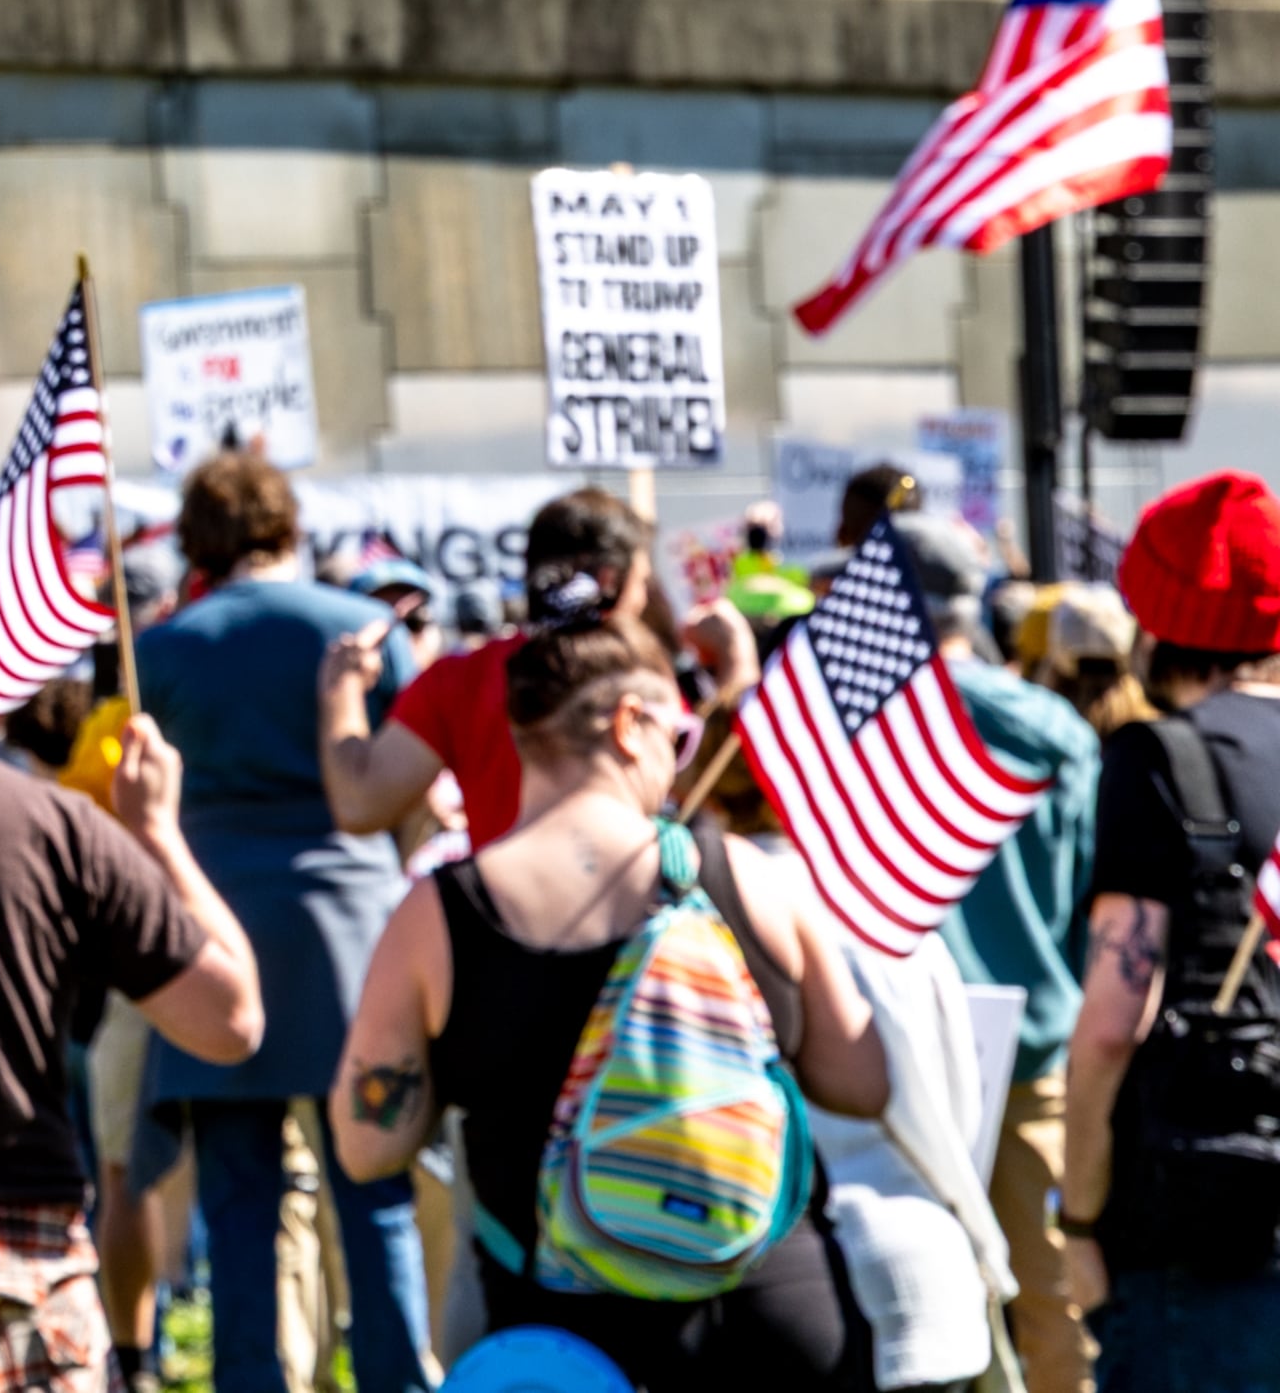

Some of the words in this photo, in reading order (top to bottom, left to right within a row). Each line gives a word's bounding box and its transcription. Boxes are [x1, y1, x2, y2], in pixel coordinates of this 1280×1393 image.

[550, 191, 653, 218] MAY
[676, 200, 688, 218] 1
[554, 233, 653, 266] STAND
[665, 235, 699, 267] UP
[559, 278, 588, 309] TO
[603, 279, 702, 312] TRUMP
[562, 330, 708, 383] GENERAL
[561, 394, 718, 456] STRIKE
